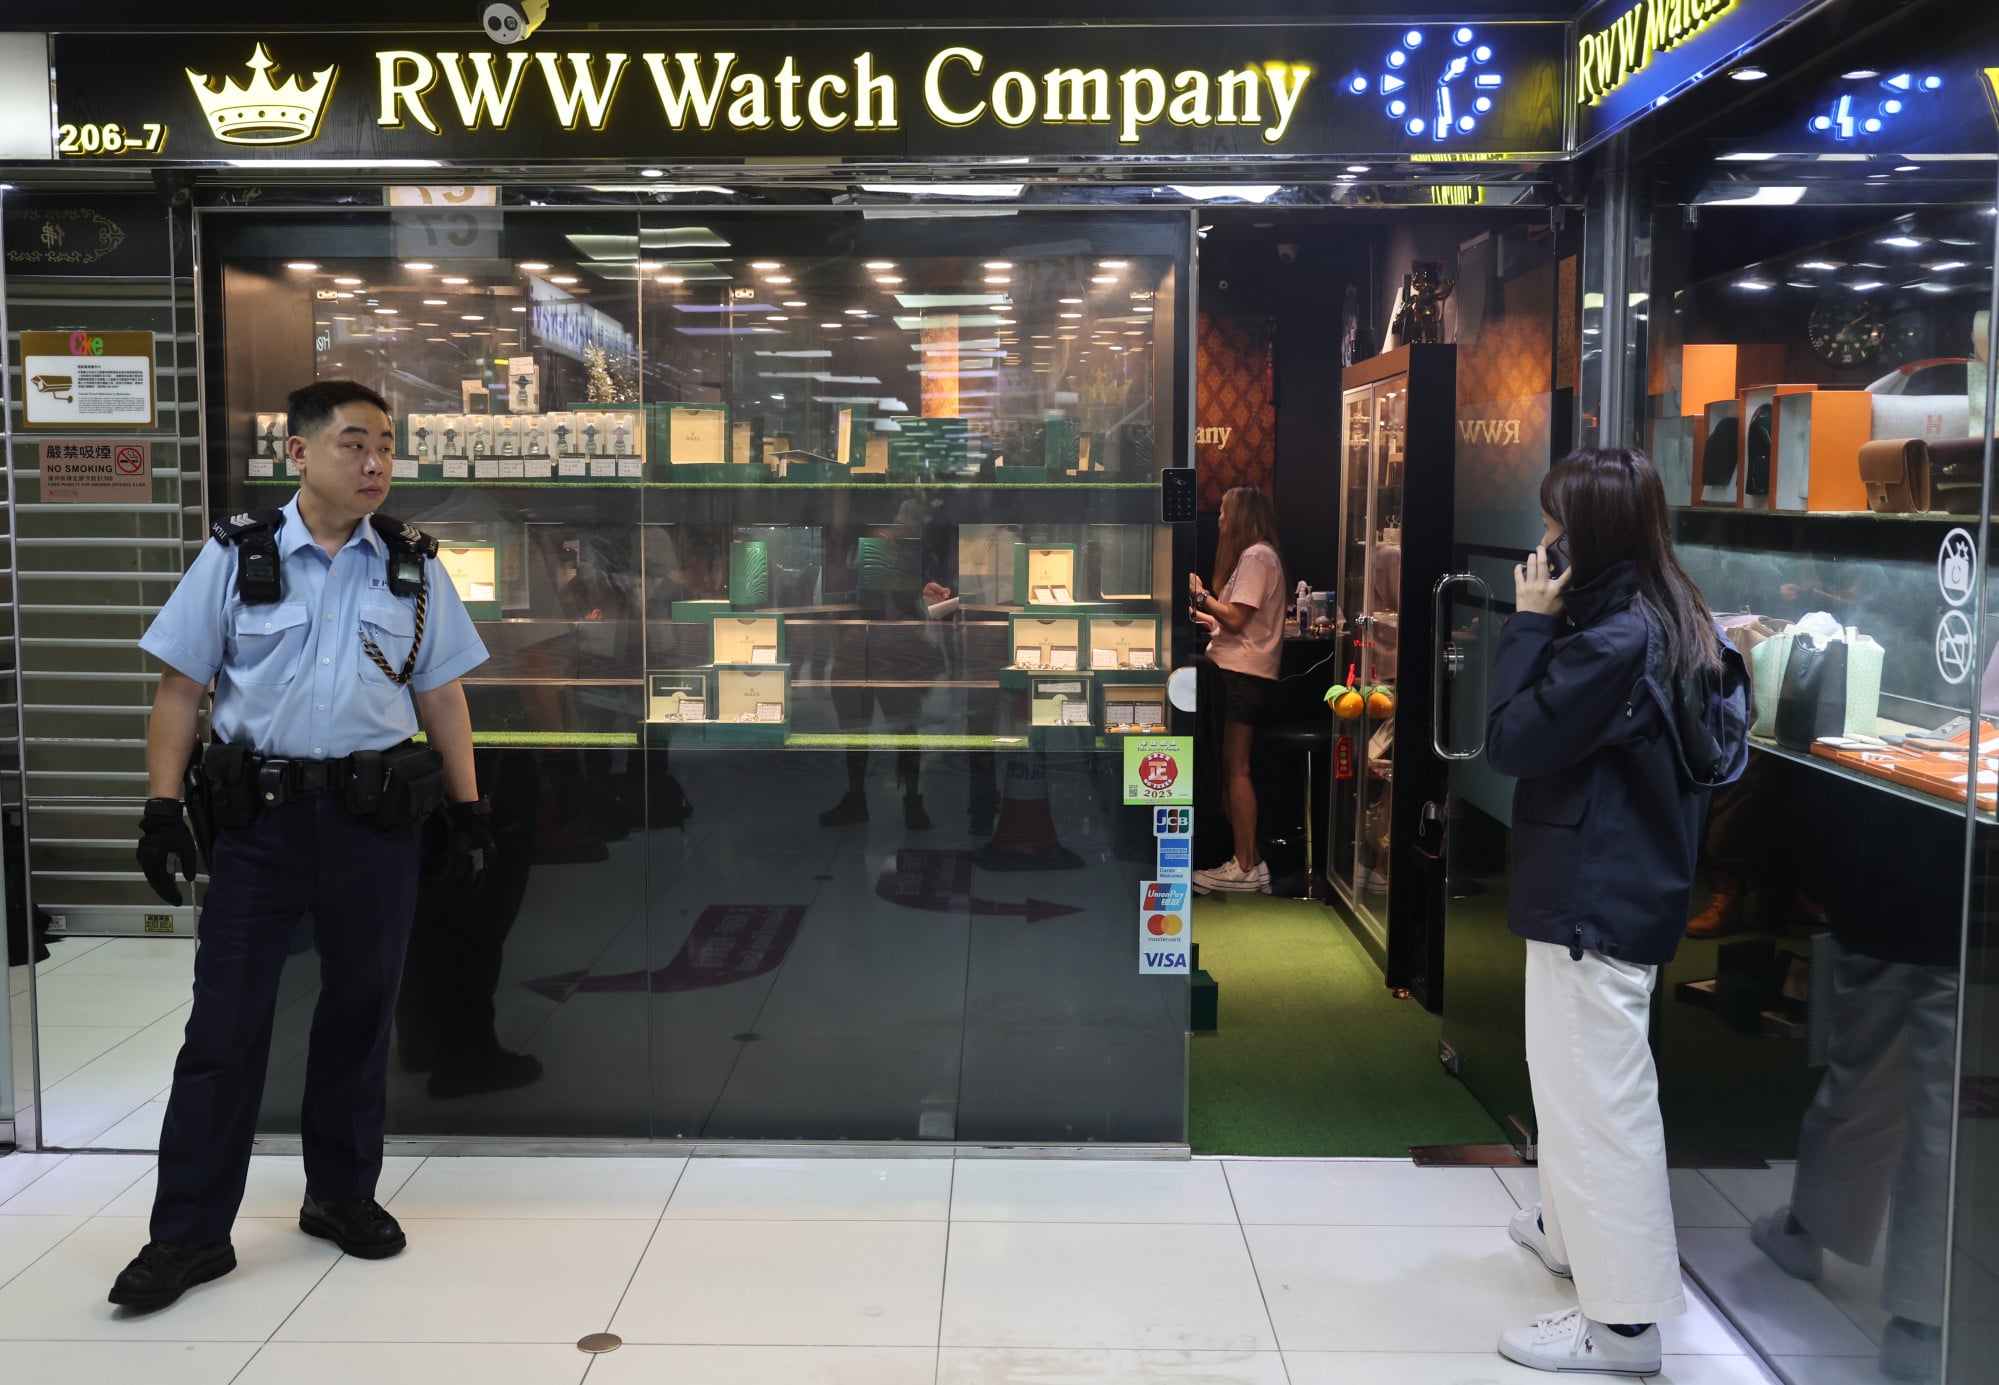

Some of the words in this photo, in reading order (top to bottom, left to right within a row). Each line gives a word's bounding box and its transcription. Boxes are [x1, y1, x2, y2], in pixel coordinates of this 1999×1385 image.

[1577, 2, 1648, 105] RWW
[376, 51, 629, 133] RWW
[643, 51, 898, 130] Watch
[925, 47, 1311, 143] Company
[59, 123, 167, 154] 206-7
[1926, 415, 1943, 435] H
[46, 445, 112, 459] 嚴禁吸煙
[47, 464, 62, 473] NO
[65, 464, 113, 473] SMOKING
[1147, 761, 1168, 781] 正
[1143, 789, 1173, 798] 2023
[1156, 816, 1189, 827] JCB
[1147, 890, 1185, 901] UnionPay
[1144, 952, 1187, 968] VISA
